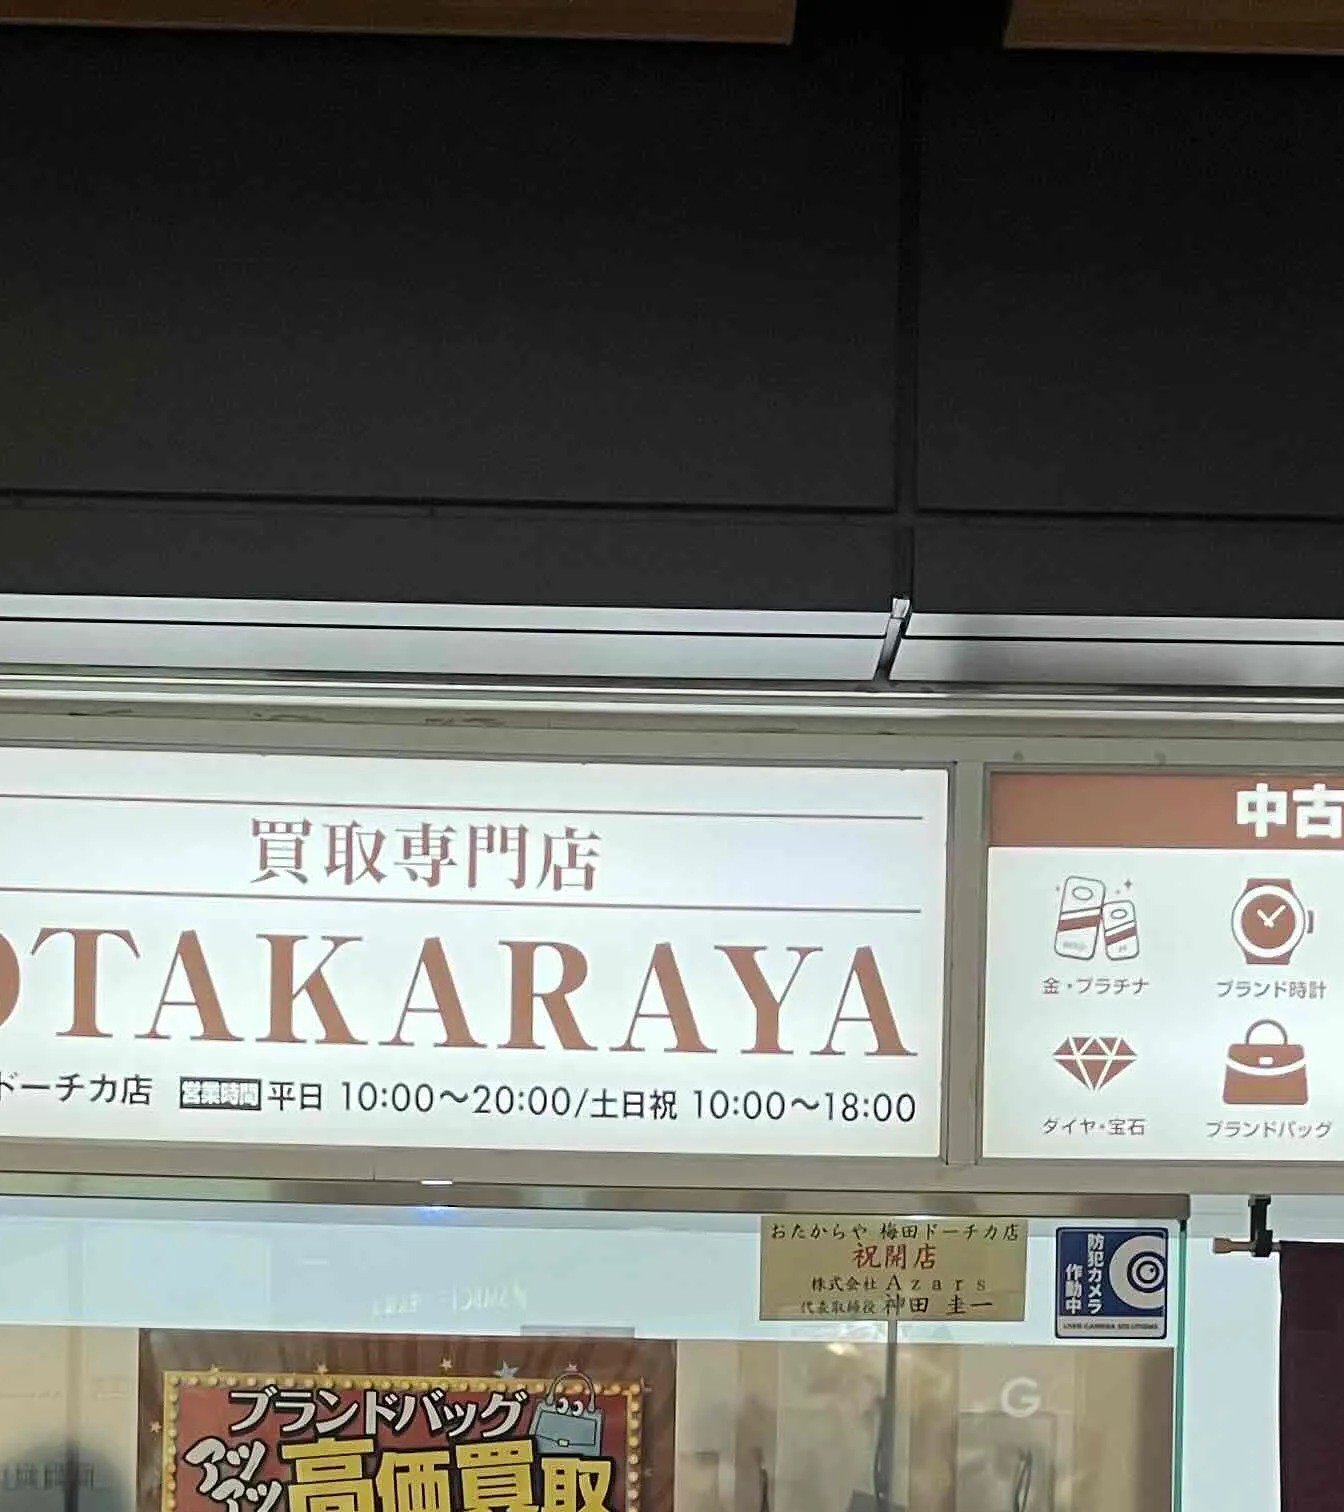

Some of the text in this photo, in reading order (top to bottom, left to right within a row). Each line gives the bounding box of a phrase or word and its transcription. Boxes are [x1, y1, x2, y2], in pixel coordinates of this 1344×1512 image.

[249, 816, 603, 893] 買取専門店
[1216, 979, 1327, 1000] ブランド時計
[267, 1080, 323, 1112] 平日
[770, 1222, 1020, 1241] おたからや 梅田ドーチカ店
[852, 1242, 938, 1271] 祝開店
[812, 1275, 878, 1292] 株式会社
[1087, 1232, 1105, 1315] 防犯カメラ
[1064, 1263, 1083, 1315] 作動中
[884, 1293, 929, 1317] 神田
[229, 1384, 528, 1439] ブランドバッグ
